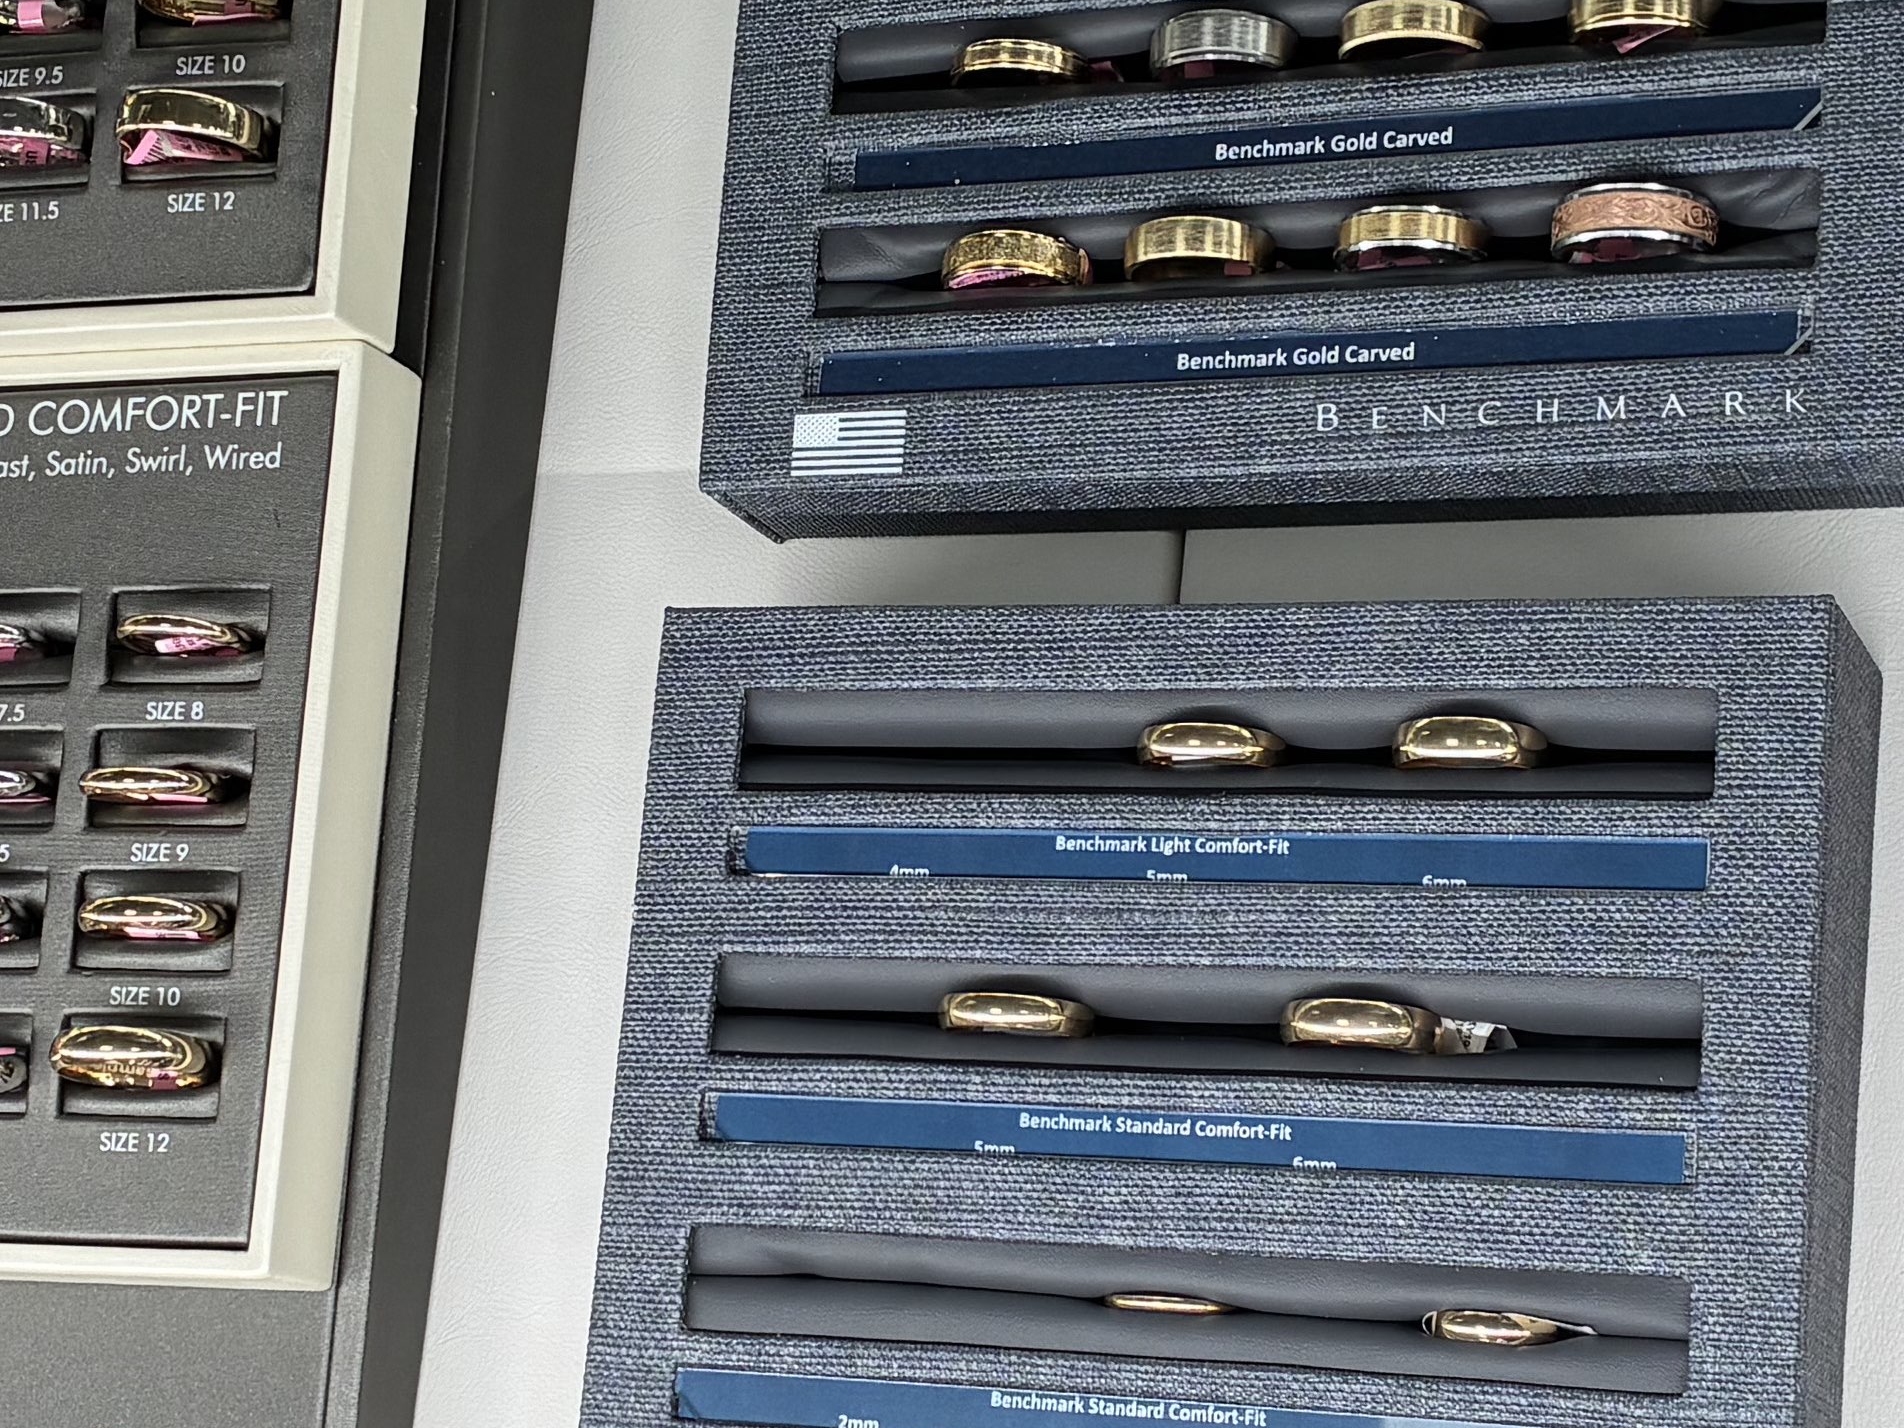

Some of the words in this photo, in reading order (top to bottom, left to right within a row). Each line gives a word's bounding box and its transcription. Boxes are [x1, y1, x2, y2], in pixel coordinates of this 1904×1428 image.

[175, 55, 215, 76] SIZE
[222, 54, 246, 74] 10
[1215, 135, 1326, 161] Benchmark
[1330, 131, 1378, 153] Gold
[1383, 125, 1453, 149] Carved
[20, 200, 59, 221] 11.5
[167, 192, 206, 214] SIZE
[212, 190, 235, 211] 12
[1176, 347, 1288, 371] Benchmark
[1292, 344, 1340, 366] Gold
[1344, 341, 1415, 363] Carved
[28, 390, 289, 436] COMFORT-FIT
[1315, 388, 1809, 432] BENCHMARK
[44, 449, 115, 479] Satin,
[124, 444, 193, 476] Swirl,
[203, 441, 283, 470] Wired
[145, 701, 192, 727] SIZE
[190, 701, 204, 720] 8
[1055, 832, 1153, 853] Benchmark
[1151, 833, 1197, 856] Light
[1194, 834, 1290, 855] Comfort-Fit
[109, 985, 151, 1005] SIZE
[156, 986, 181, 1006] 10
[1019, 1112, 1112, 1133] Benchmark
[1115, 1116, 1192, 1136] Standard
[1194, 1120, 1292, 1141] Comfort-Fit
[99, 1131, 140, 1152] SIZE
[147, 1132, 170, 1153] 12
[990, 1391, 1085, 1414] Benchmark
[1088, 1399, 1164, 1420] Standard
[1168, 1404, 1267, 1427] Comfort-Fit
